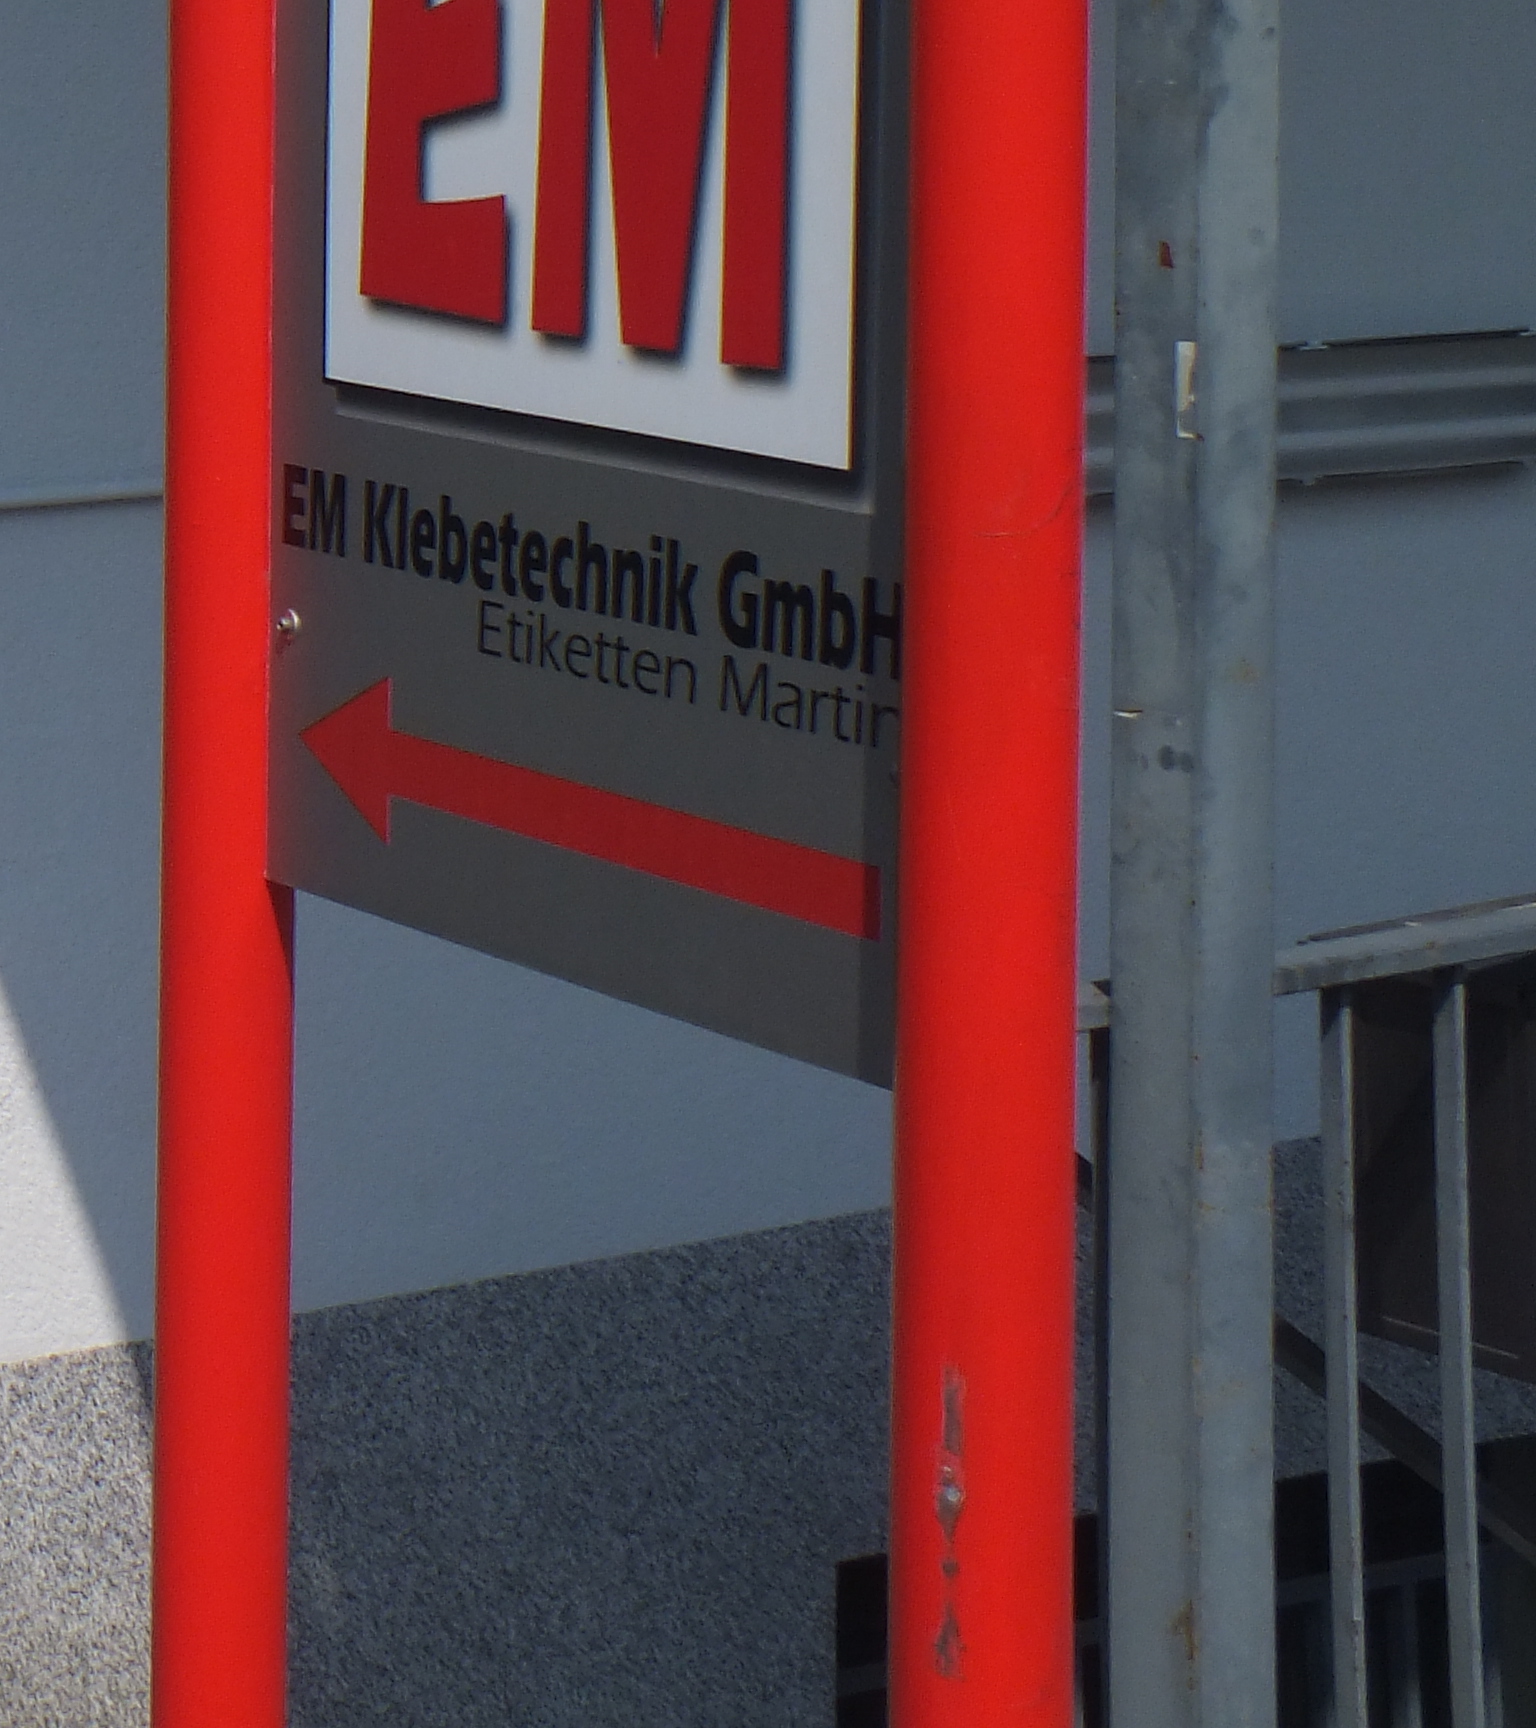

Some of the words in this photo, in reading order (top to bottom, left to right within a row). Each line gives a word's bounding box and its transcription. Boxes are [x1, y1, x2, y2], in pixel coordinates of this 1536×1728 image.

[281, 462, 347, 558] EM
[363, 479, 698, 636] Klebetechnik
[718, 550, 903, 680] GmbH
[479, 599, 696, 704] Etiketten
